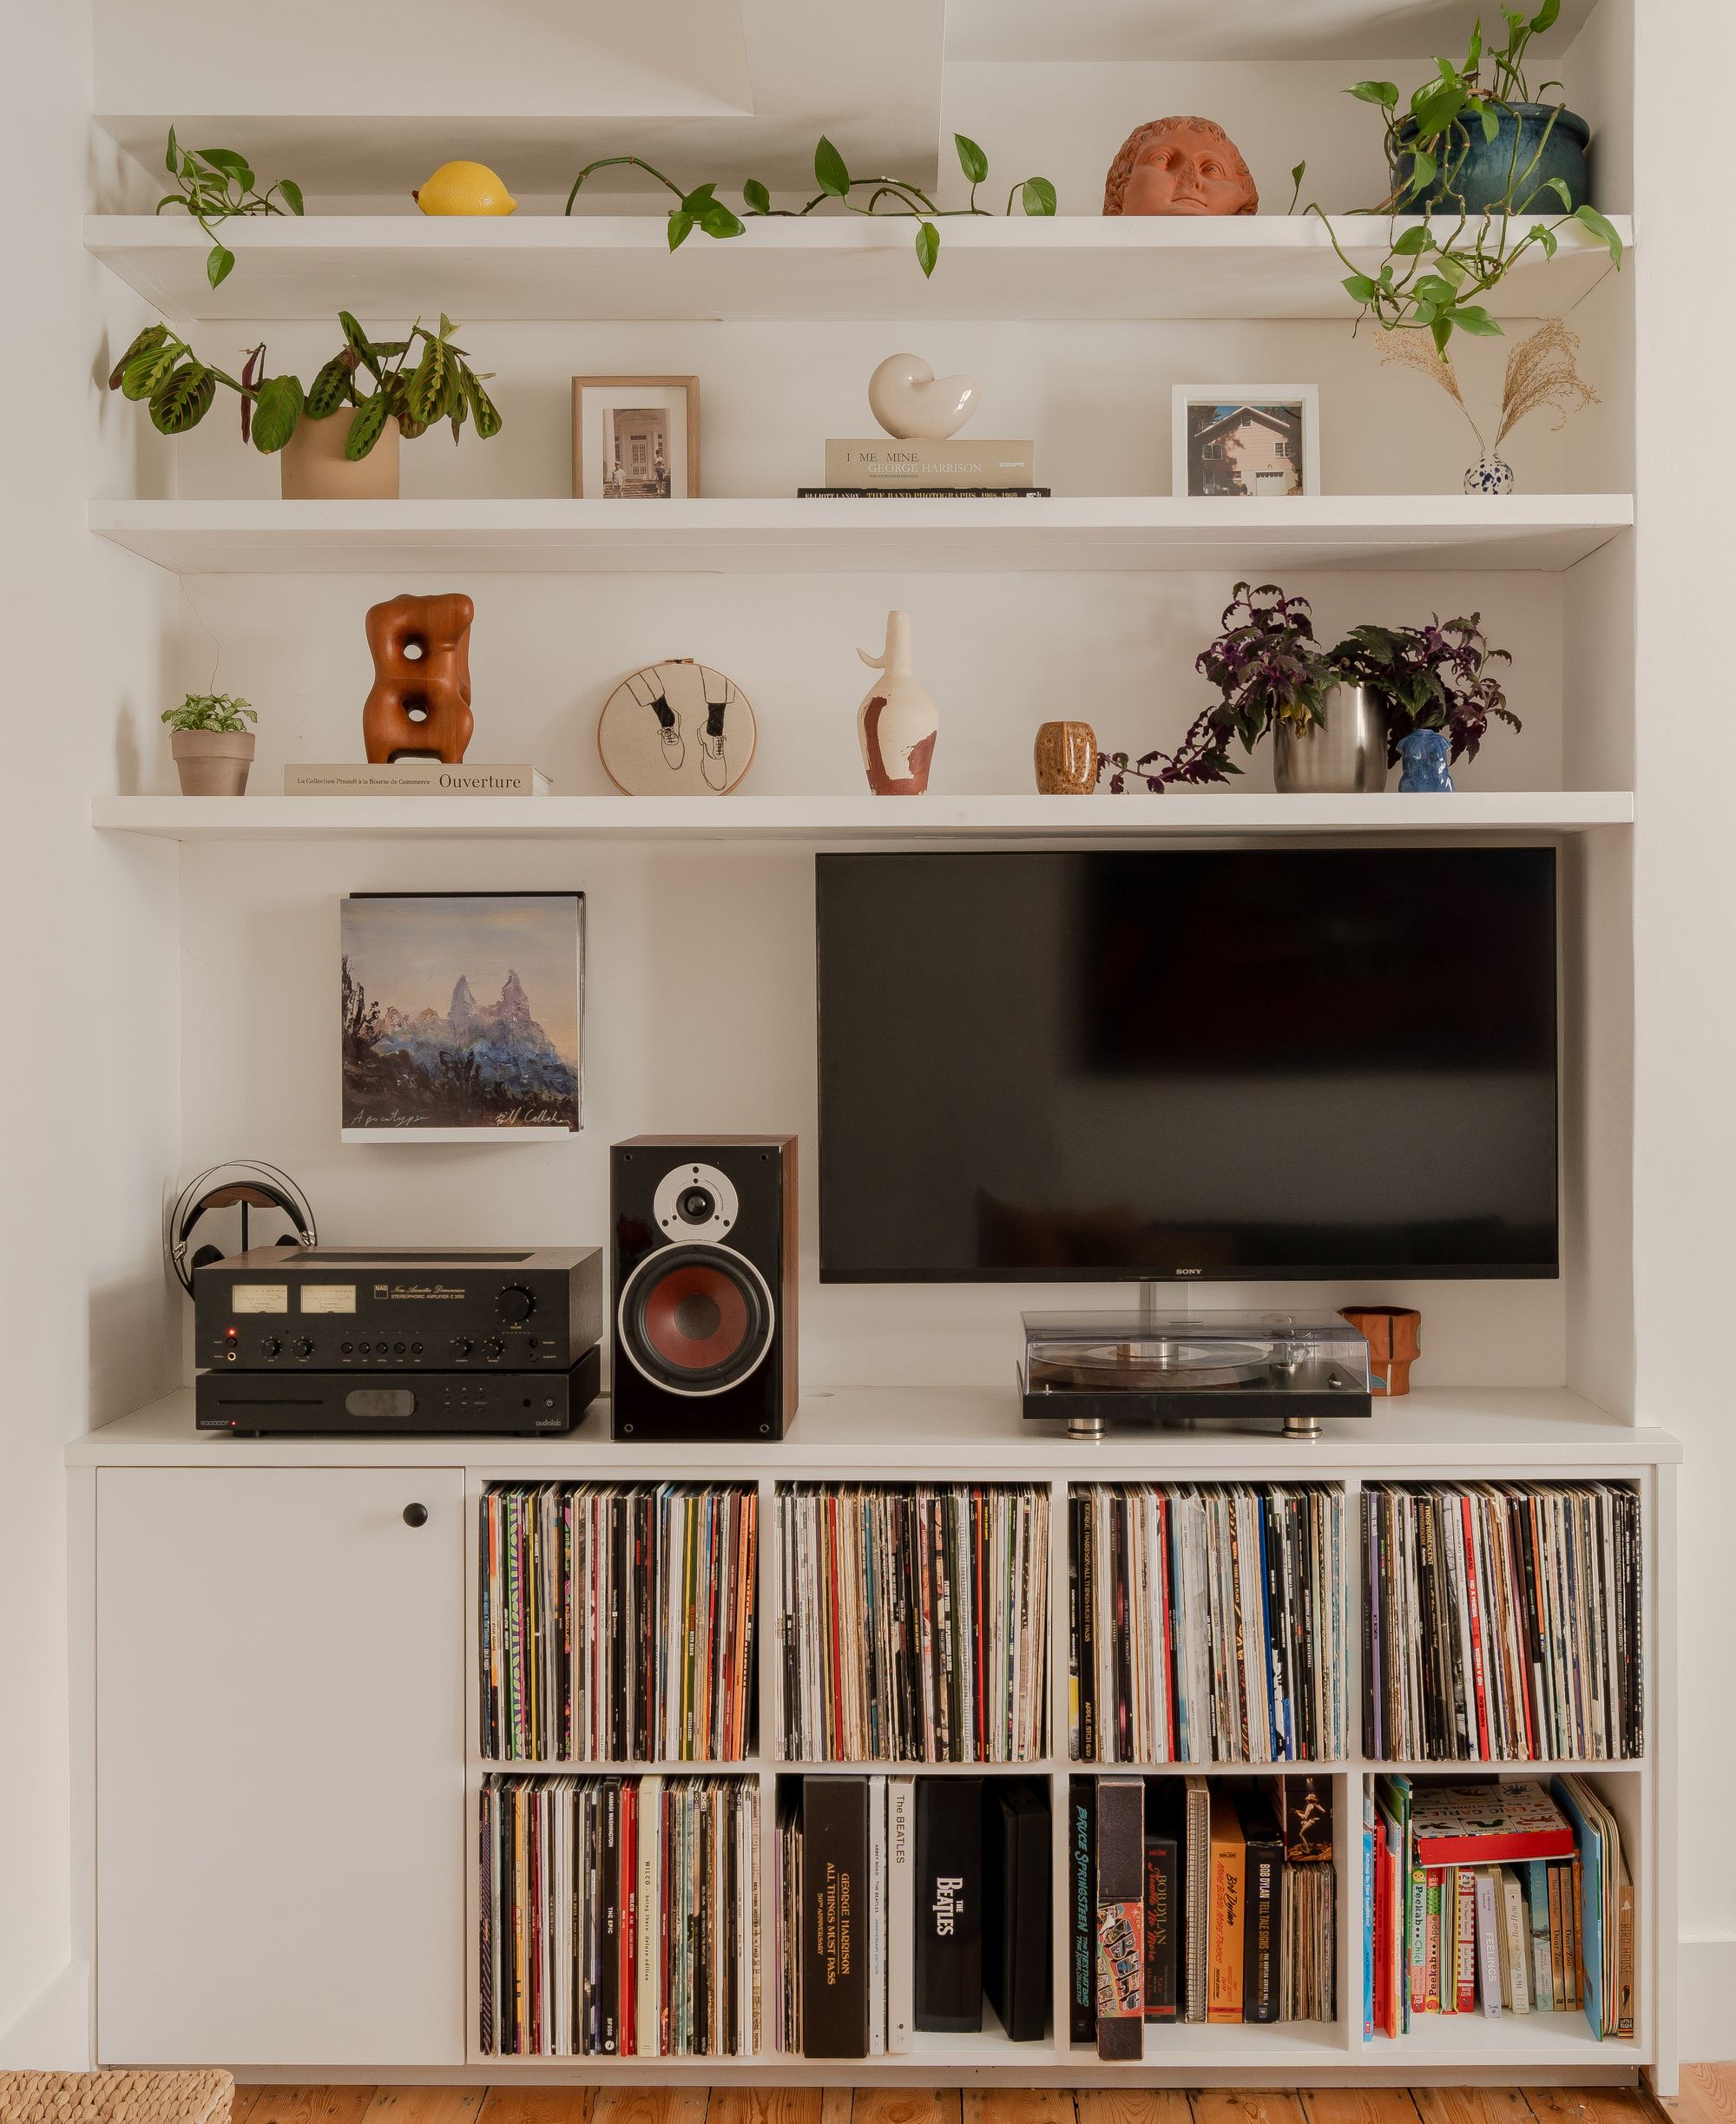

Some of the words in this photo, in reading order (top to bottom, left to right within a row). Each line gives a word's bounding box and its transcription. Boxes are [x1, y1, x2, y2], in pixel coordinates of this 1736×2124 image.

[846, 452, 850, 462] I
[859, 452, 878, 462] ME
[886, 452, 919, 462] MINE
[868, 463, 918, 473] GEORGE
[922, 463, 982, 473] HARRISON
[439, 774, 521, 788] Ouverture
[495, 1107, 521, 1126] Bill
[525, 1109, 571, 1125] Callahan
[1425, 1506, 1434, 1565] PHOSPHORESCENT
[896, 1795, 905, 1813] The
[1489, 1806, 1527, 1815] ERIC
[896, 1816, 905, 1863] BEATLES
[1076, 1805, 1087, 1852] BRUCE
[827, 1862, 835, 1882] ALL
[1216, 1861, 1225, 1885] MORE
[1259, 1864, 1270, 1876] BOB
[1075, 1851, 1089, 1932] SPRINGSTEEN
[1148, 1862, 1159, 1905] Trouble
[1157, 1875, 1167, 1902] BOB
[1226, 1873, 1237, 1894] Bob
[1259, 1878, 1270, 1898] DYLAN
[827, 1884, 835, 1923] THINGS
[933, 1877, 963, 1936] BEATLES
[1224, 1893, 1237, 1926] Dylan
[1259, 1901, 1269, 1914] TELL
[1148, 1909, 1157, 1927] No
[1157, 1904, 1167, 1945] DYLAN
[1215, 1910, 1224, 1932] MORE
[1259, 1915, 1269, 1929] TALE
[827, 1926, 835, 1955] MUST
[1259, 1930, 1269, 1949] SIGNS
[1621, 1923, 1631, 1943] BIRD
[1148, 1931, 1157, 1961] More
[1215, 1933, 1224, 1964] TRACKS
[1485, 1932, 1496, 1983] FEELINGS
[827, 1958, 835, 1985] PASS
[1621, 1947, 1631, 1975] HOUSE
